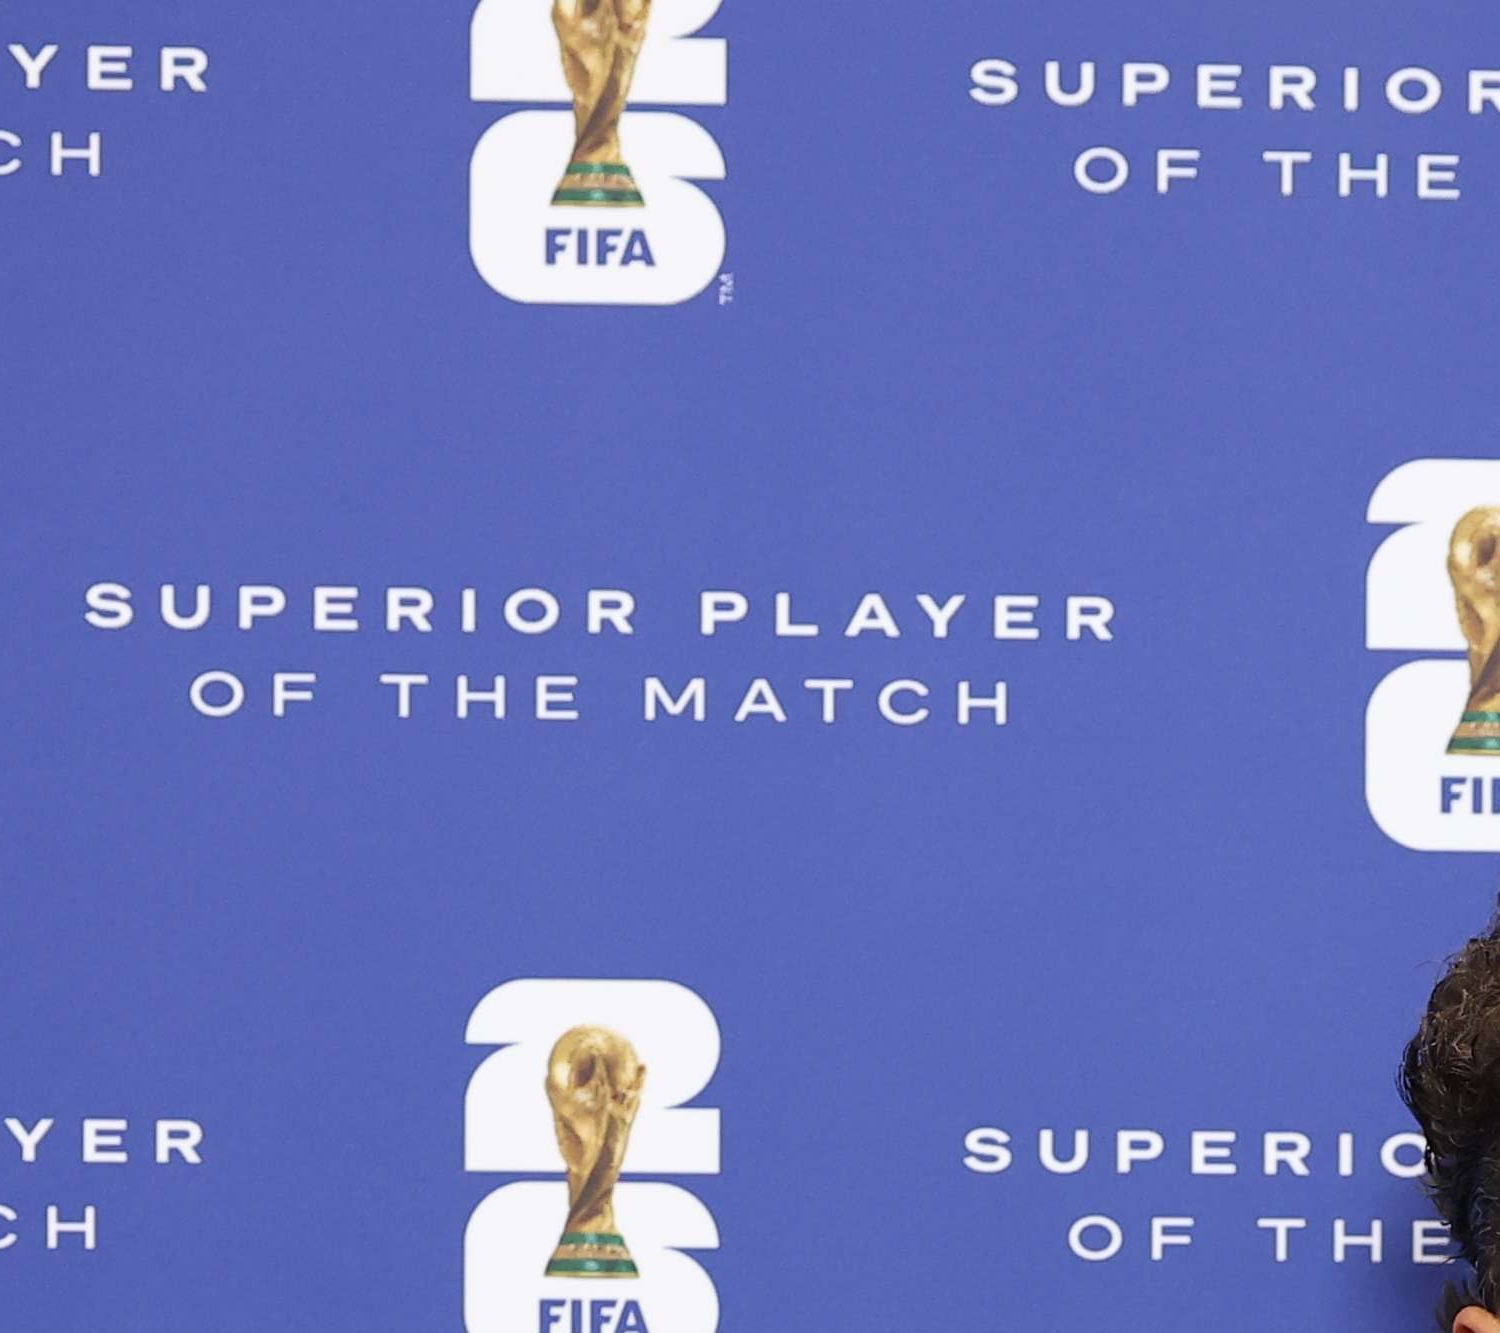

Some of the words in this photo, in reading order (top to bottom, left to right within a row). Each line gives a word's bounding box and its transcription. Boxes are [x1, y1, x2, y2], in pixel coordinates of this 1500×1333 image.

[1074, 147, 1201, 194] OF
[1262, 150, 1461, 200] THE
[544, 227, 656, 267] FIFA
[84, 582, 635, 635] SUPERIOR
[700, 591, 1114, 641] PLAYER
[189, 671, 317, 717] OF
[379, 673, 579, 720] THE
[644, 677, 1007, 725] MATCH
[963, 1127, 1427, 1178] SUPERIO
[1068, 1215, 1195, 1261] OF
[1257, 1218, 1454, 1263] THE
